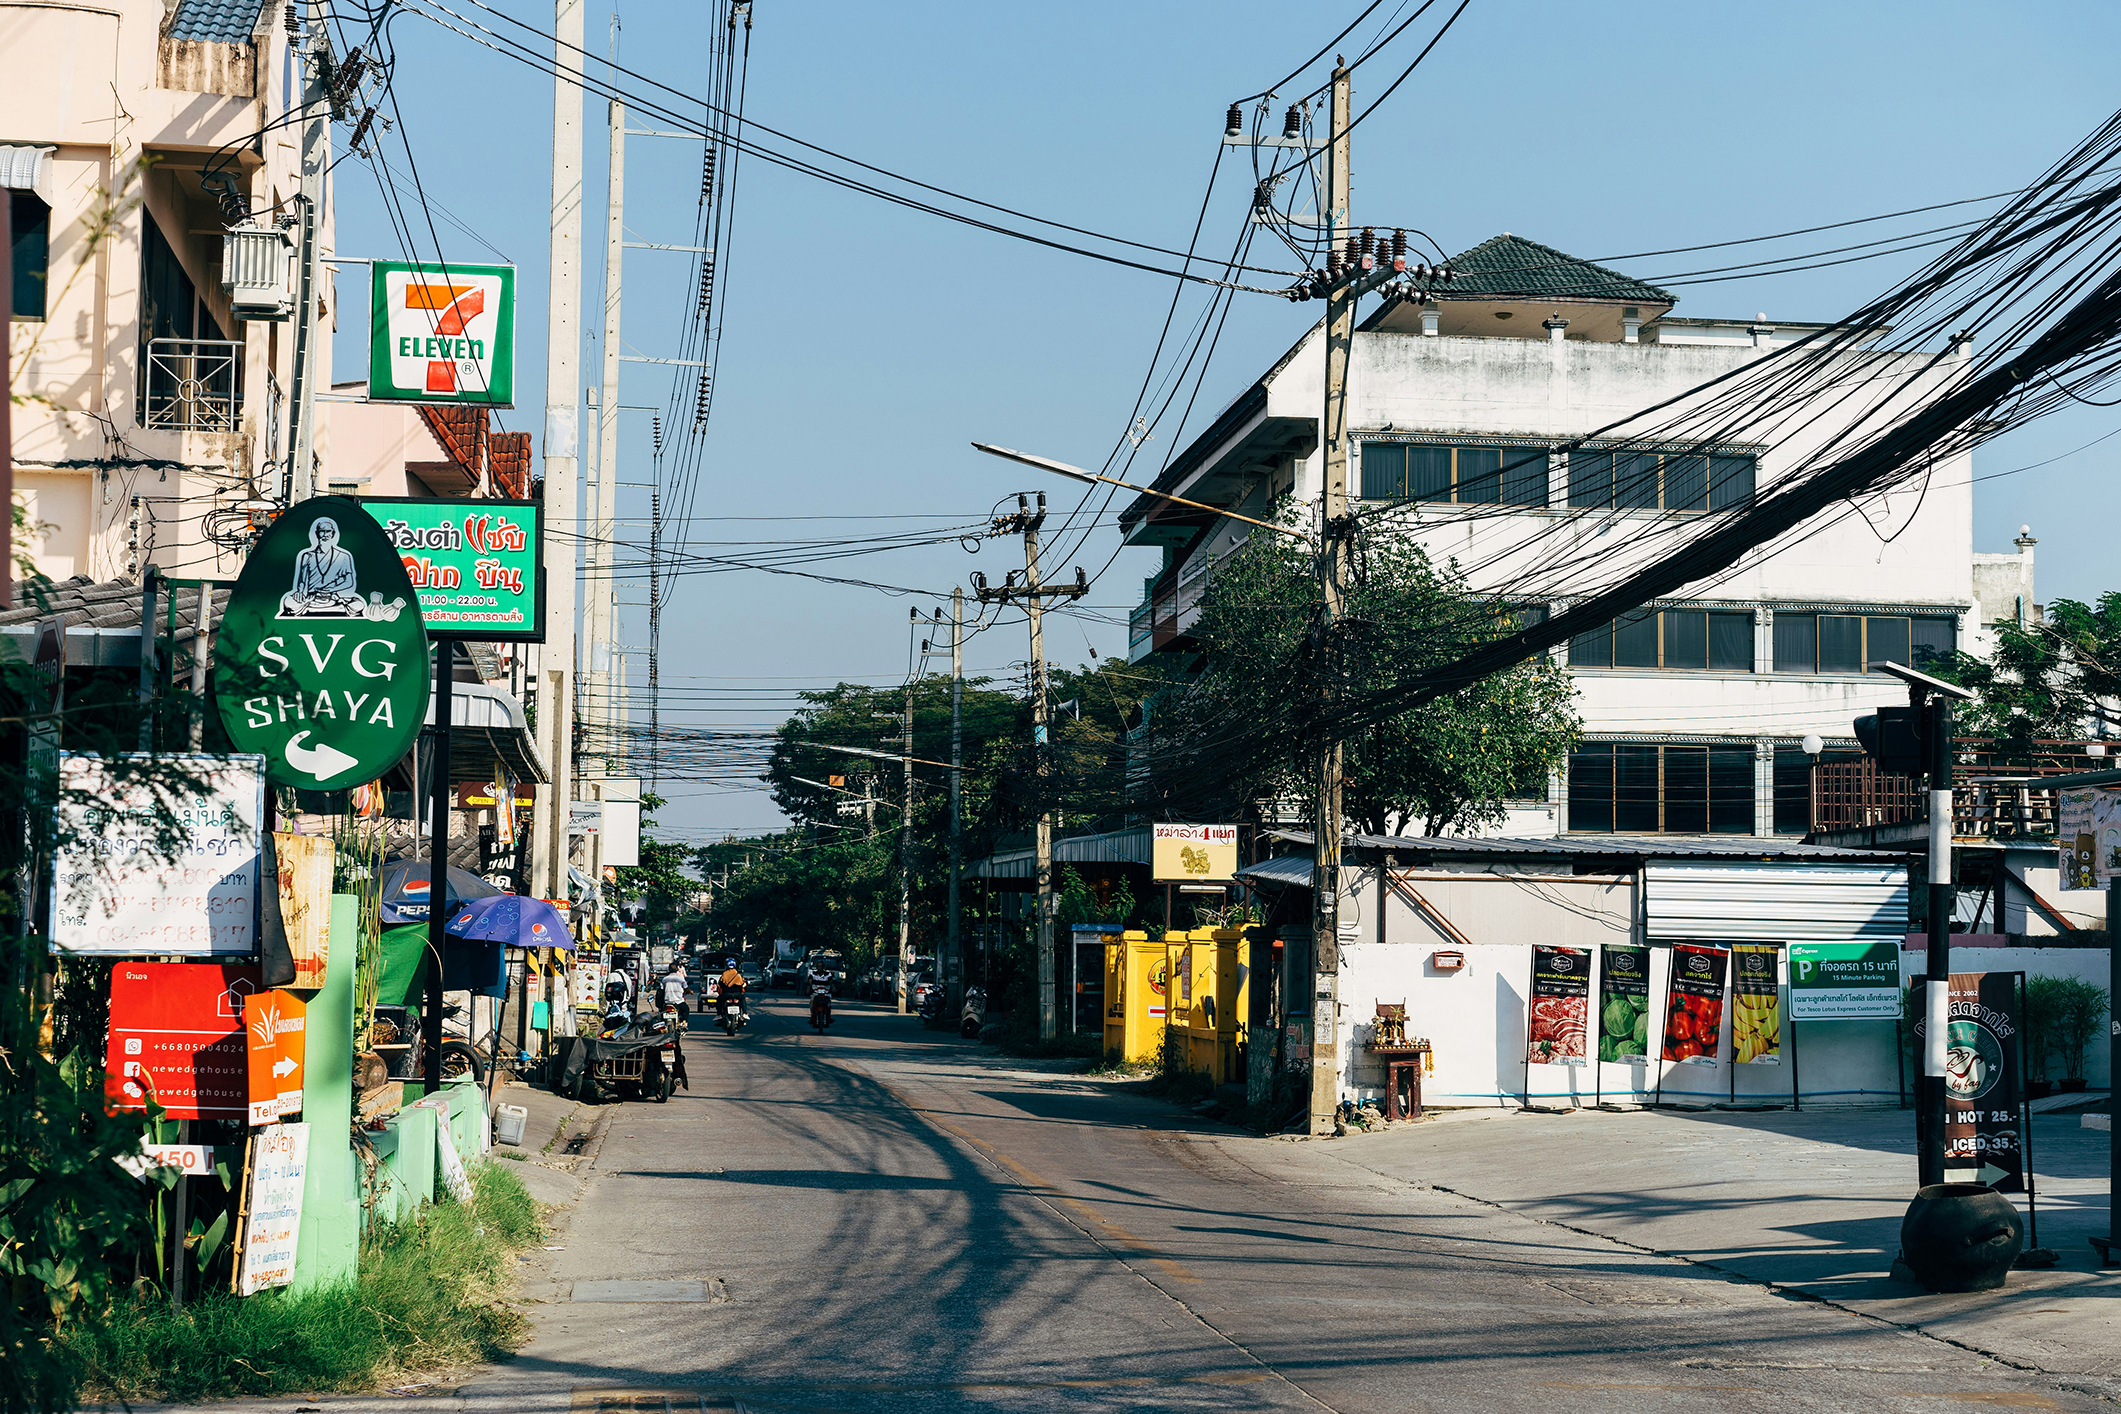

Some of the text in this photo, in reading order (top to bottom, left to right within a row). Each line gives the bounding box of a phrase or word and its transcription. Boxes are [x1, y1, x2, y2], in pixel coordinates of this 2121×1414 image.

[420, 596, 447, 605] 11.00
[458, 597, 484, 605] 22.00
[257, 633, 398, 682] SVG
[243, 689, 394, 729] SHAYA
[219, 871, 248, 885] บาท
[395, 904, 431, 917] PEP
[1798, 960, 1813, 980] P
[1820, 957, 1897, 972] ที่จอดรถ 15 นาที
[1863, 974, 1885, 982] Parking
[153, 1043, 245, 1053] +66805004024
[152, 1064, 244, 1075] newedgehouse
[1951, 1078, 1963, 1091] by
[151, 1087, 243, 1098] newedgehouse
[1957, 1110, 2018, 1124] HOT 25.-
[1991, 1137, 2018, 1150] 35.-
[155, 1151, 196, 1169] 150
